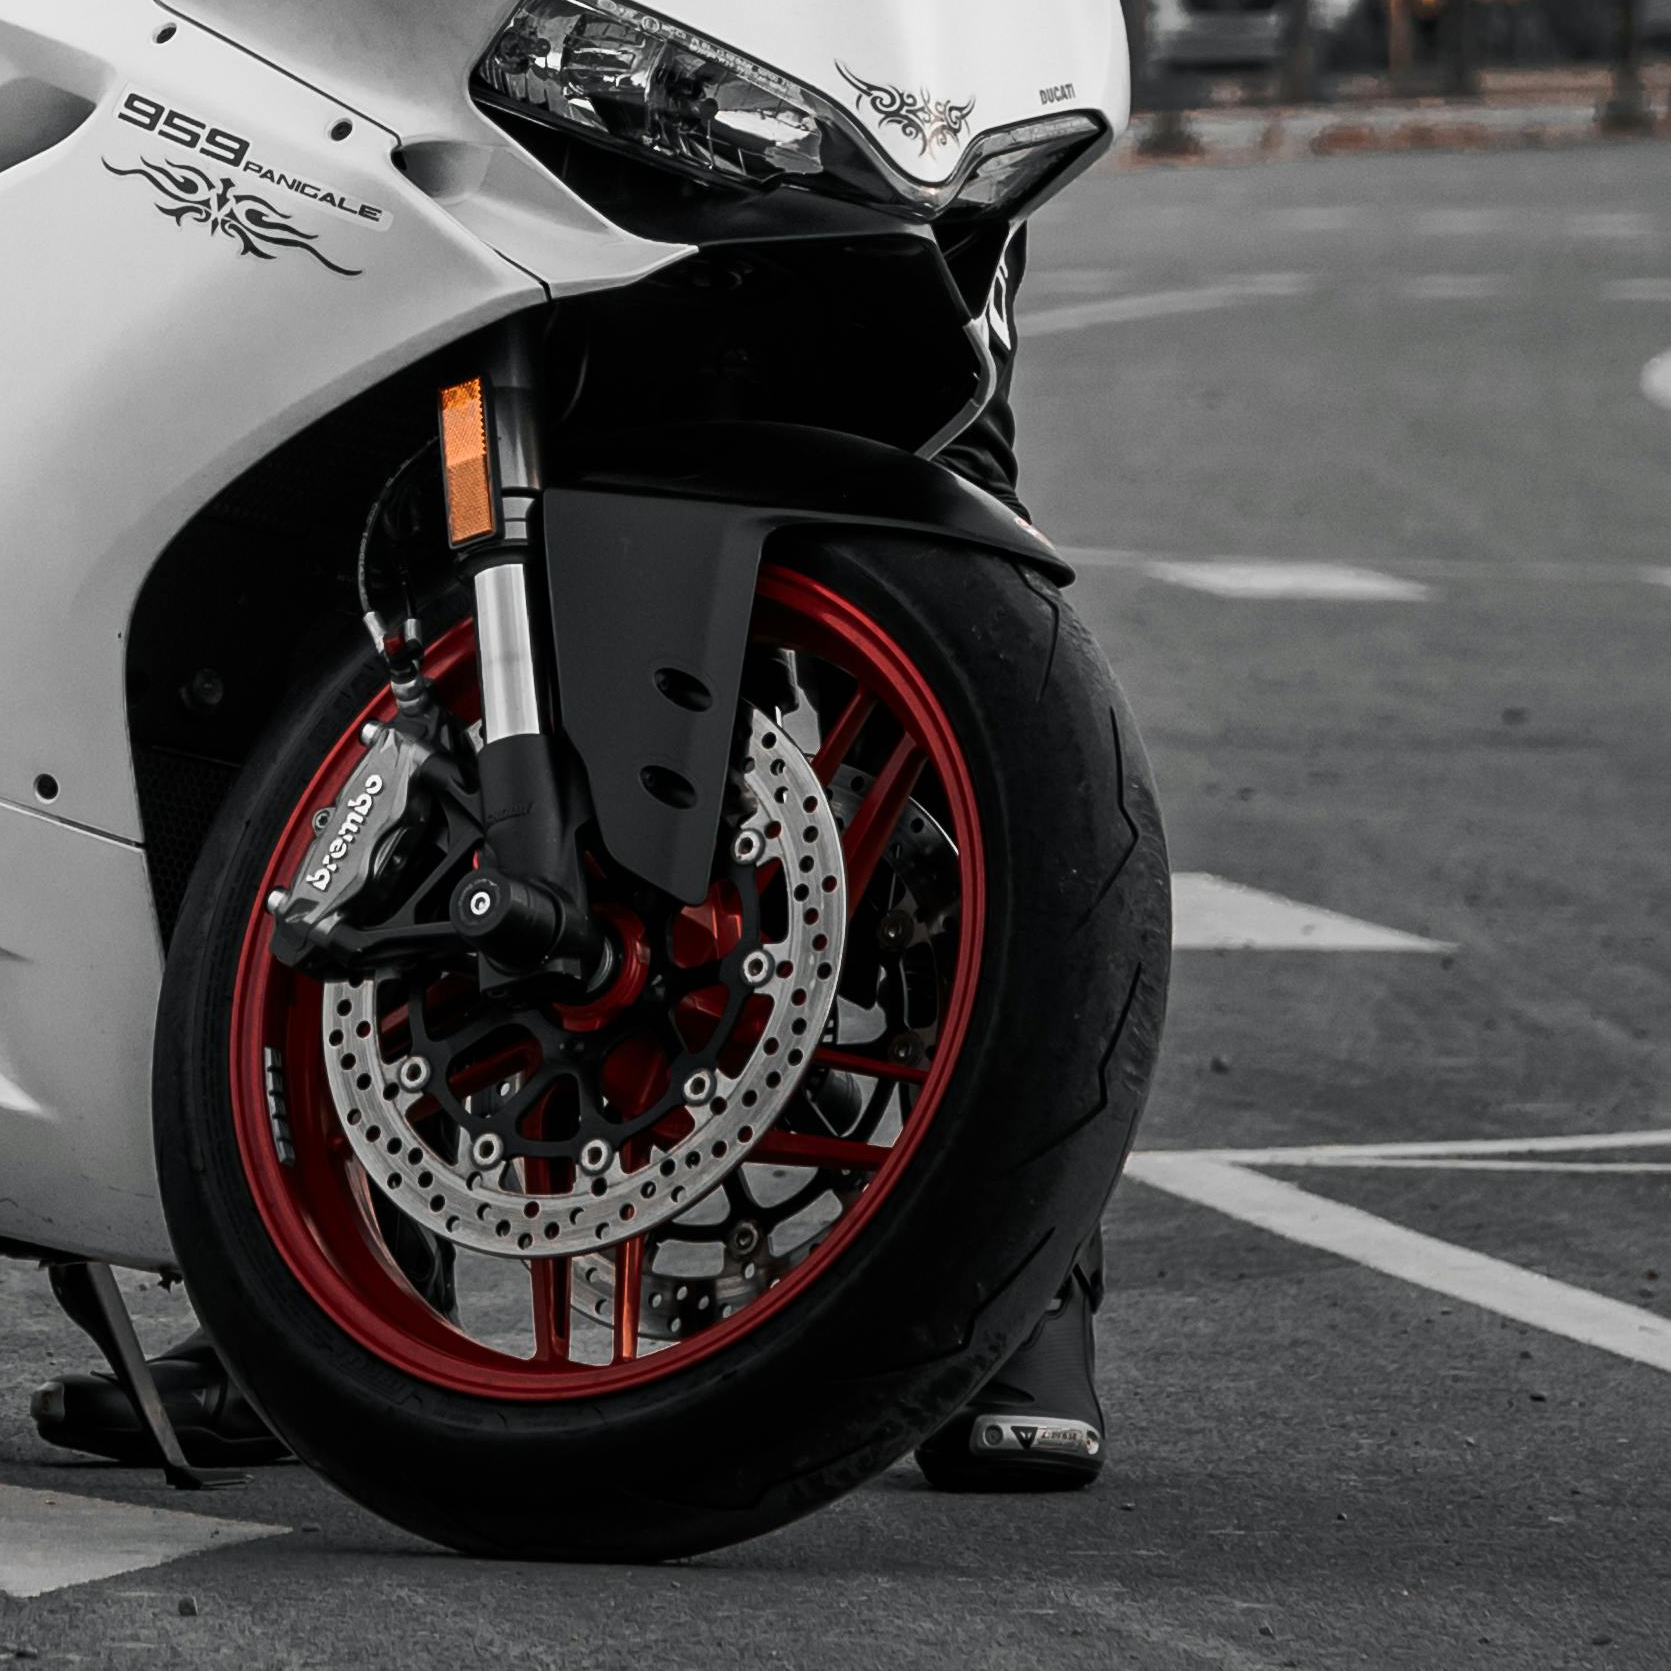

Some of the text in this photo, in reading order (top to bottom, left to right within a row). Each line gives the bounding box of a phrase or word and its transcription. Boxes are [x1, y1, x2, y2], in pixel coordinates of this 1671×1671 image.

[1038, 82, 1077, 106] DUCATI
[117, 92, 383, 222] 959 PANIGALE
[305, 773, 384, 892] brembo
